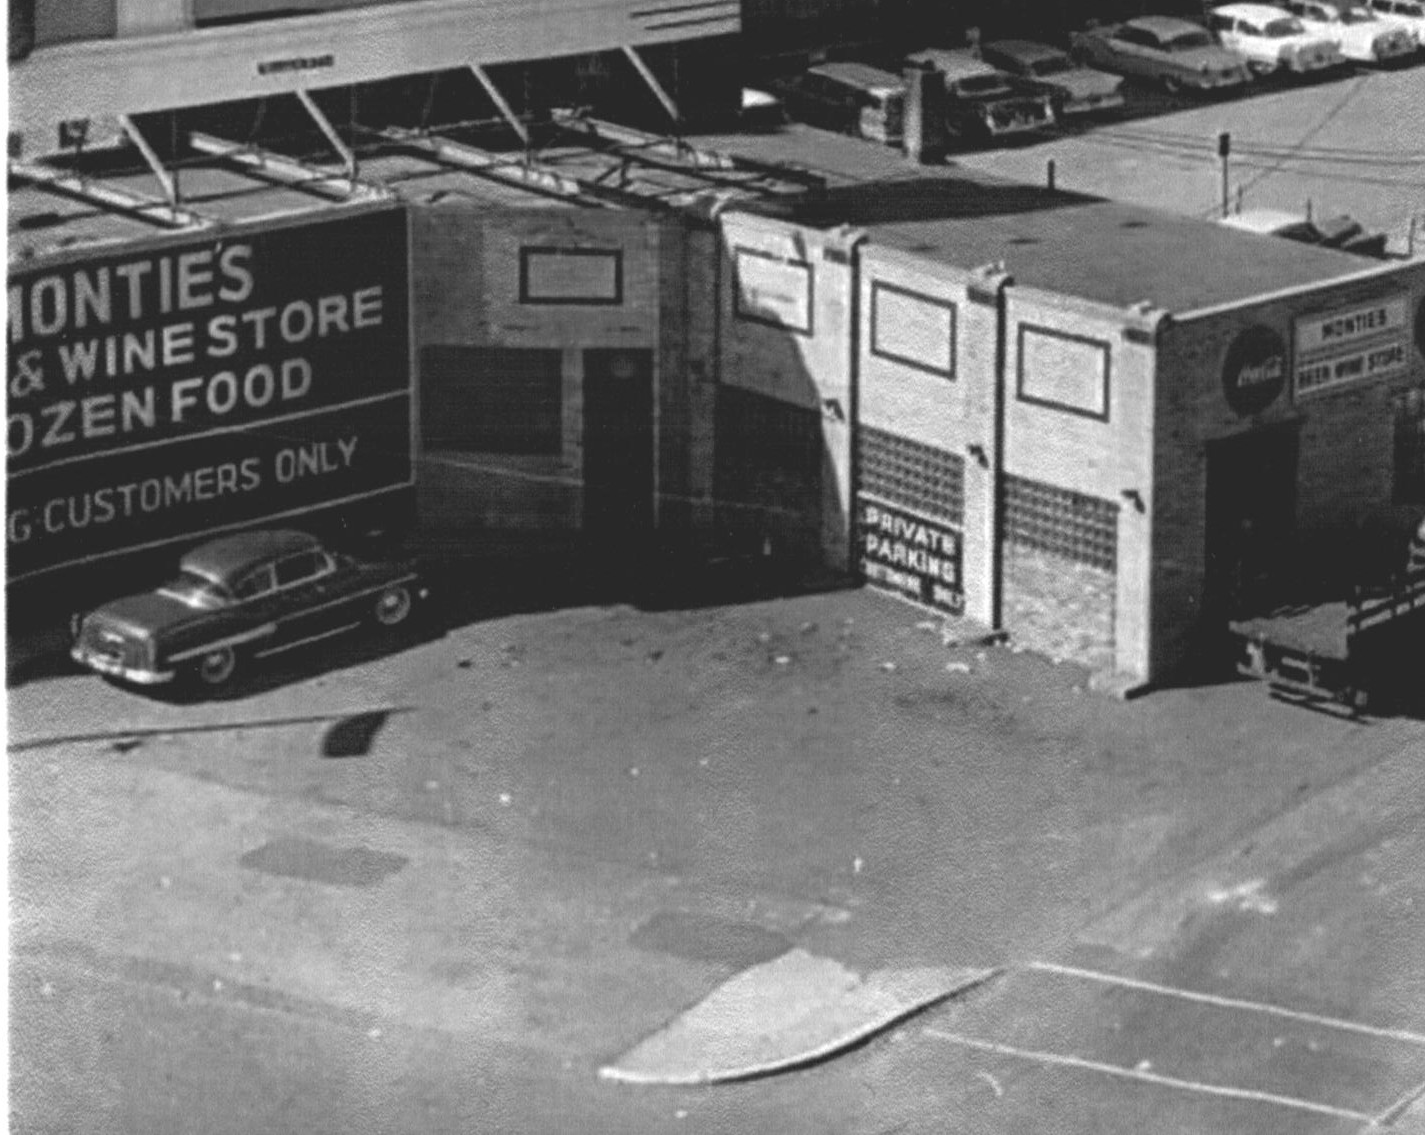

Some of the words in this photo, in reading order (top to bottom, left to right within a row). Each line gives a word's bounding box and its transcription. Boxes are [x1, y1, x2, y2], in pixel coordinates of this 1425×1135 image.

[10, 349, 45, 398] &
[58, 322, 196, 385] WINE
[206, 286, 384, 358] STORE
[171, 358, 312, 423] FOOD
[43, 458, 261, 533] CUSTOMERS
[275, 436, 358, 484] ONLY
[865, 505, 956, 557] PRIVATE
[865, 532, 956, 584] PARKING
